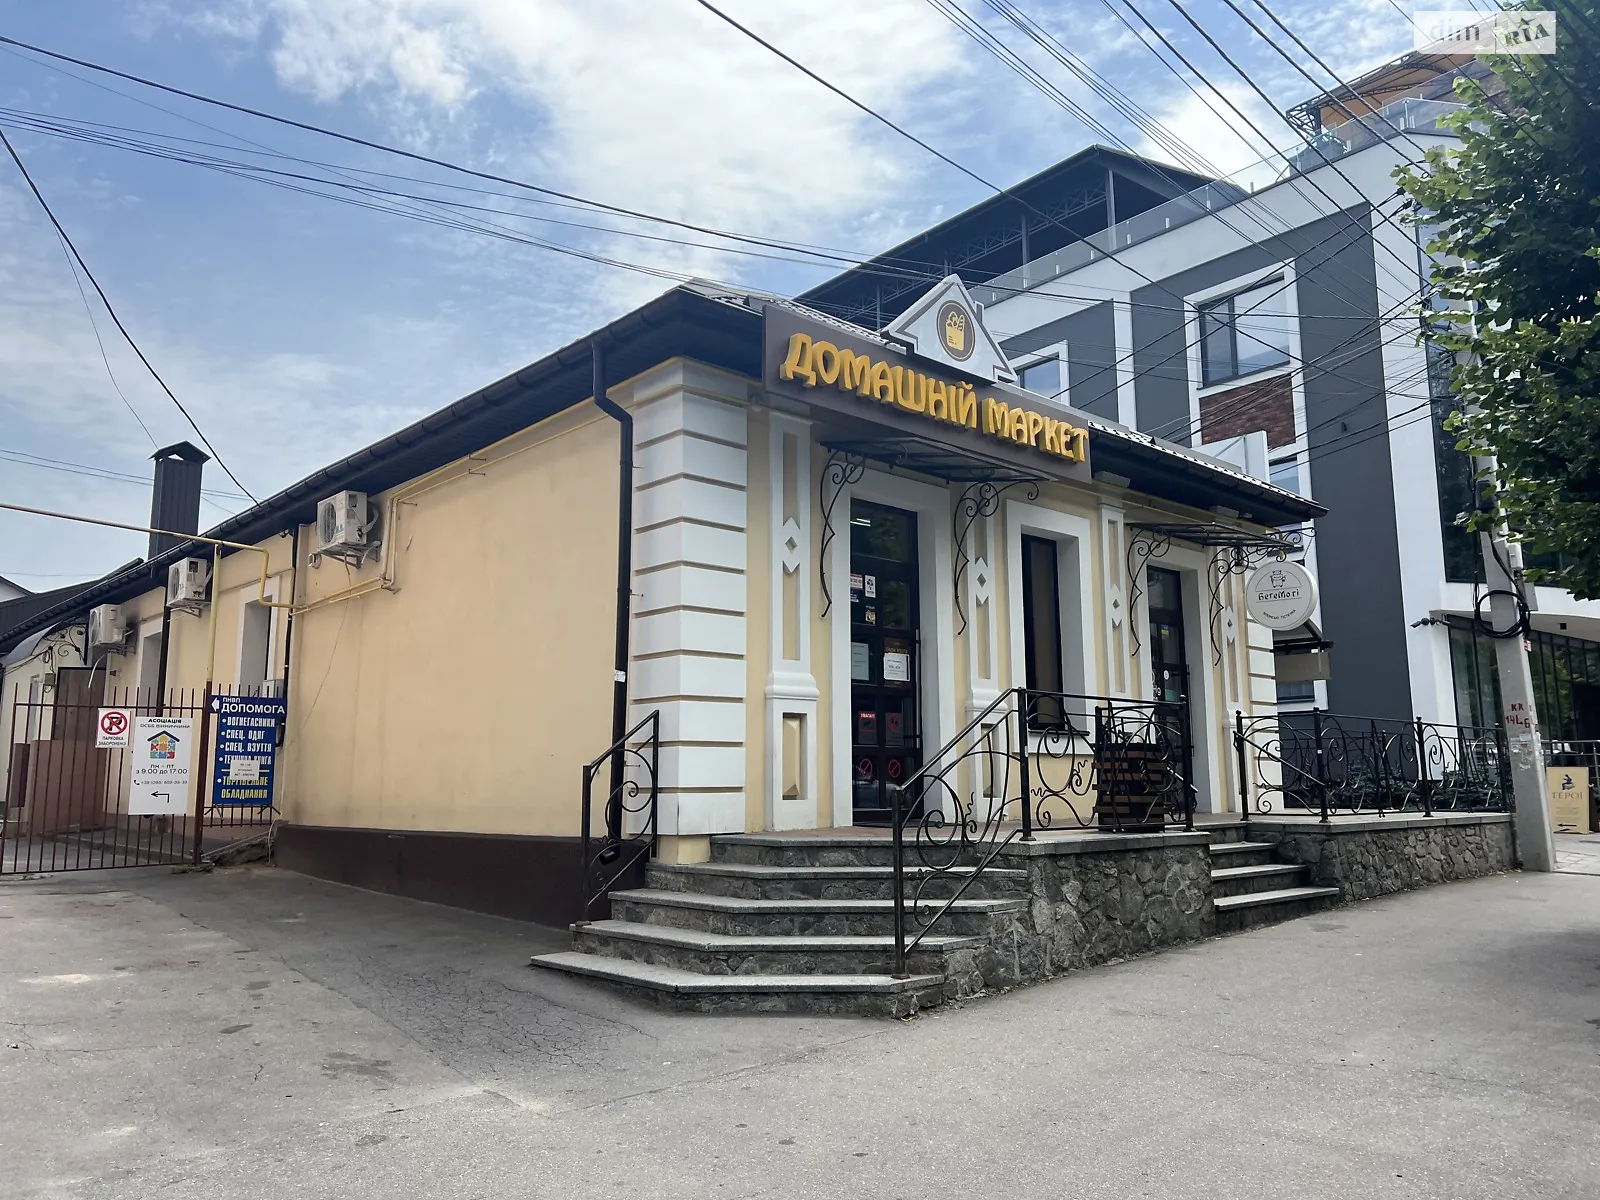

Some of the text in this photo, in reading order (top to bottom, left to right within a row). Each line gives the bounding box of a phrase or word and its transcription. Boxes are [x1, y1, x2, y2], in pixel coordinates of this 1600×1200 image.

[780, 333, 1088, 463] ДОМАШНІЙ МАРКЕТ
[221, 703, 285, 714] ДОПОМОГА
[227, 716, 276, 728] ВОГНЕГАСНИКИ
[226, 729, 265, 741] СПЕЦ. ОДЯГ
[225, 742, 272, 753] СПЕЦ. ВЗУТТЯ
[221, 788, 268, 800] ОБЛАДНАННЯ
